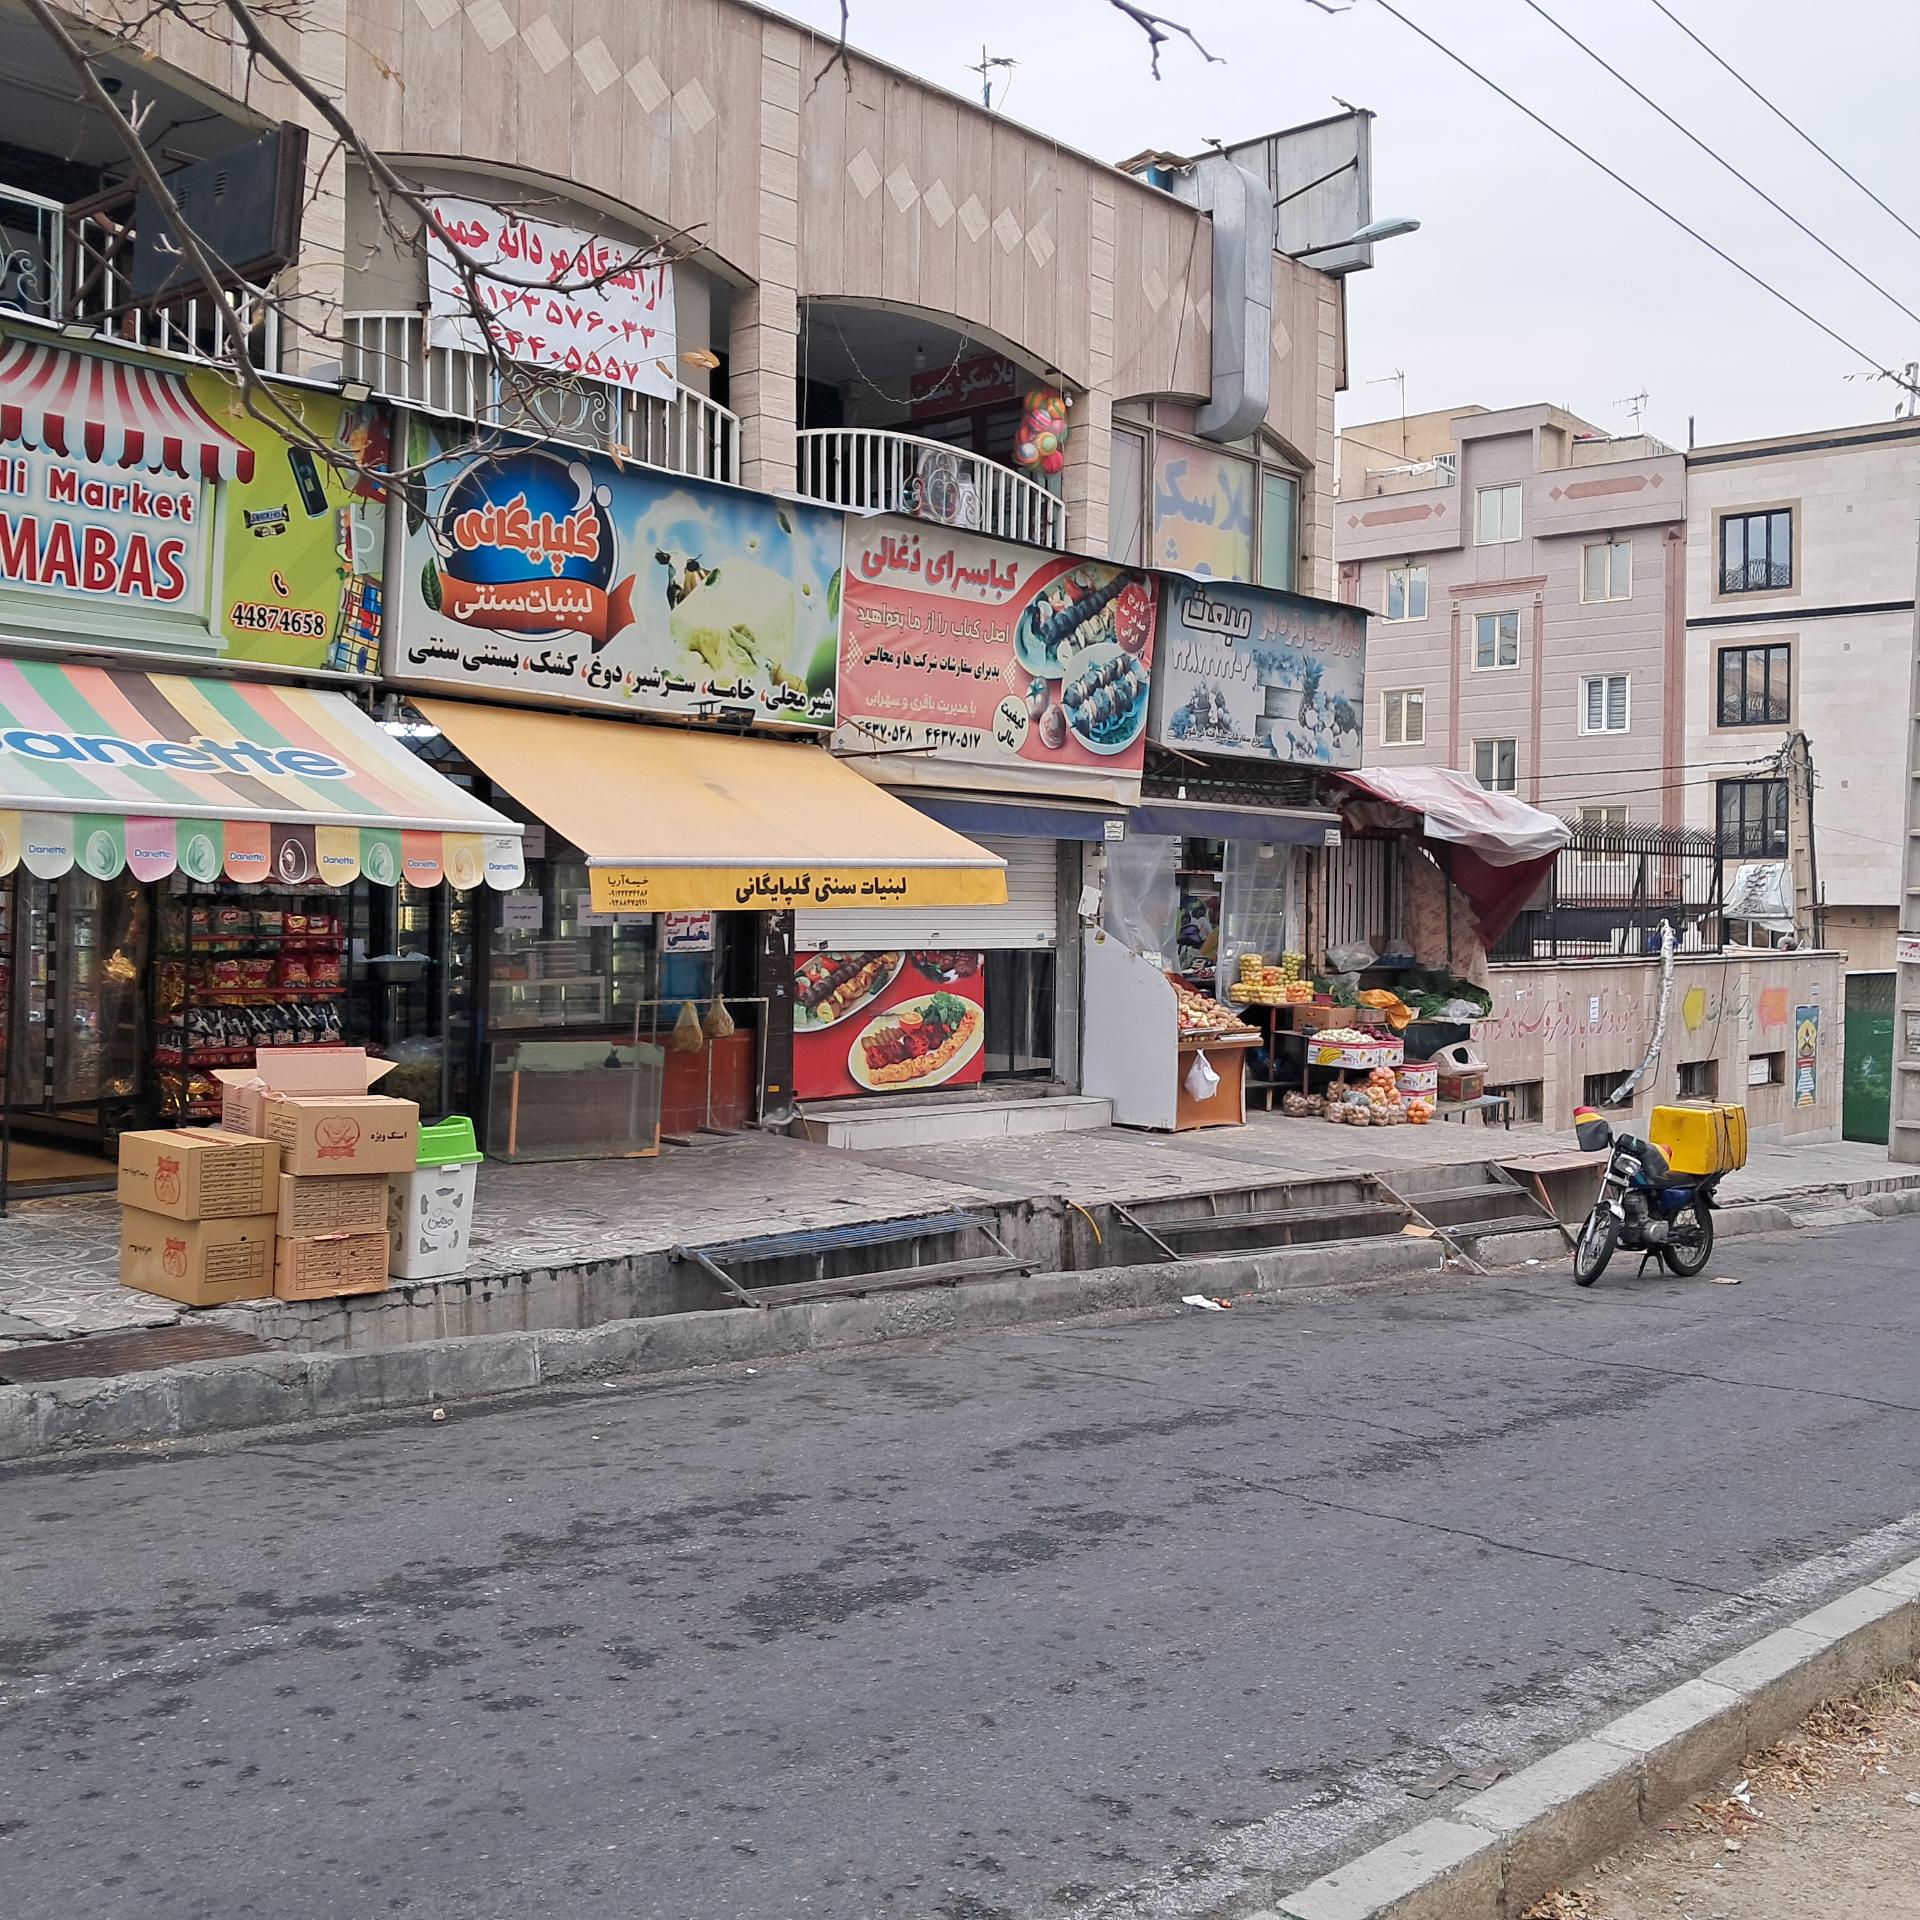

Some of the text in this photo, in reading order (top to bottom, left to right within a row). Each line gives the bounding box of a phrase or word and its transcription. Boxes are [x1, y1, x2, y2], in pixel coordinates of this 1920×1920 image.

[960, 359, 1015, 402] پلاسکو
[49, 468, 194, 522] Market
[455, 492, 600, 576] گلپایگانی
[863, 534, 1019, 598] کبابسرای ذغالی
[454, 584, 593, 622] لبنیات سنتی
[232, 603, 326, 638] 44874658
[857, 602, 905, 629] بخواهید
[907, 609, 922, 630] ما
[951, 616, 981, 640] کباب
[984, 623, 1010, 645] اصل
[408, 637, 459, 664] سنتی
[462, 644, 519, 676] بستنی
[864, 646, 893, 666] مجالس
[895, 655, 900, 669] و
[903, 650, 911, 665] ها
[940, 655, 972, 678] سفارشات
[808, 688, 833, 718] شیر
[1000, 699, 1026, 731] کیفیت
[997, 727, 1015, 748] عالی
[0, 730, 350, 777] anette
[27, 843, 67, 856] Danette
[134, 848, 170, 860] Danette
[229, 852, 265, 864] Danette
[323, 855, 354, 867] Danette
[408, 859, 438, 869] Danette
[736, 873, 907, 906] لبنیات سنتی گلپایگانی
[370, 1131, 386, 1142] ویژه
